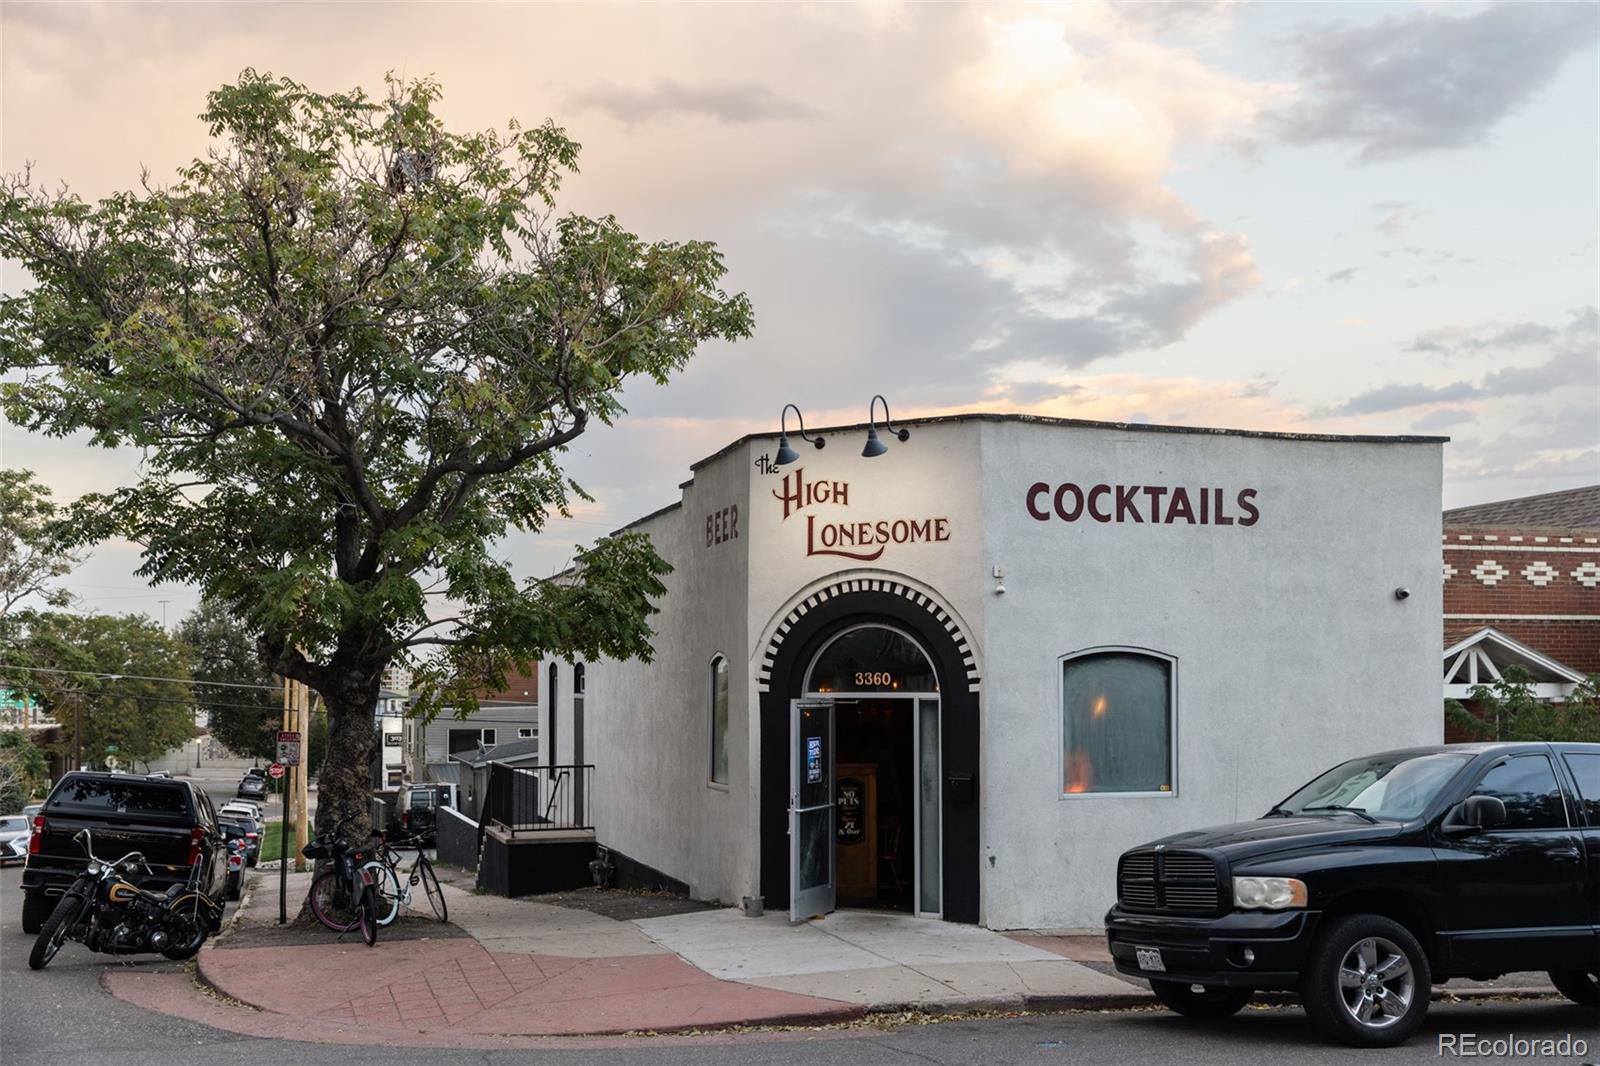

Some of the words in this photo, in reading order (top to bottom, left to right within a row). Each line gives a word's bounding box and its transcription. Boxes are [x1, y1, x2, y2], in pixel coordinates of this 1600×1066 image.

[772, 467, 849, 520] HIGH
[1026, 482, 1260, 527] COCKTAILS
[706, 504, 738, 548] BEER
[806, 515, 951, 561] LONESOME
[855, 672, 891, 686] 3360
[271, 767, 284, 775] STOP
[837, 797, 859, 806] PETS
[843, 790, 856, 798] NO
